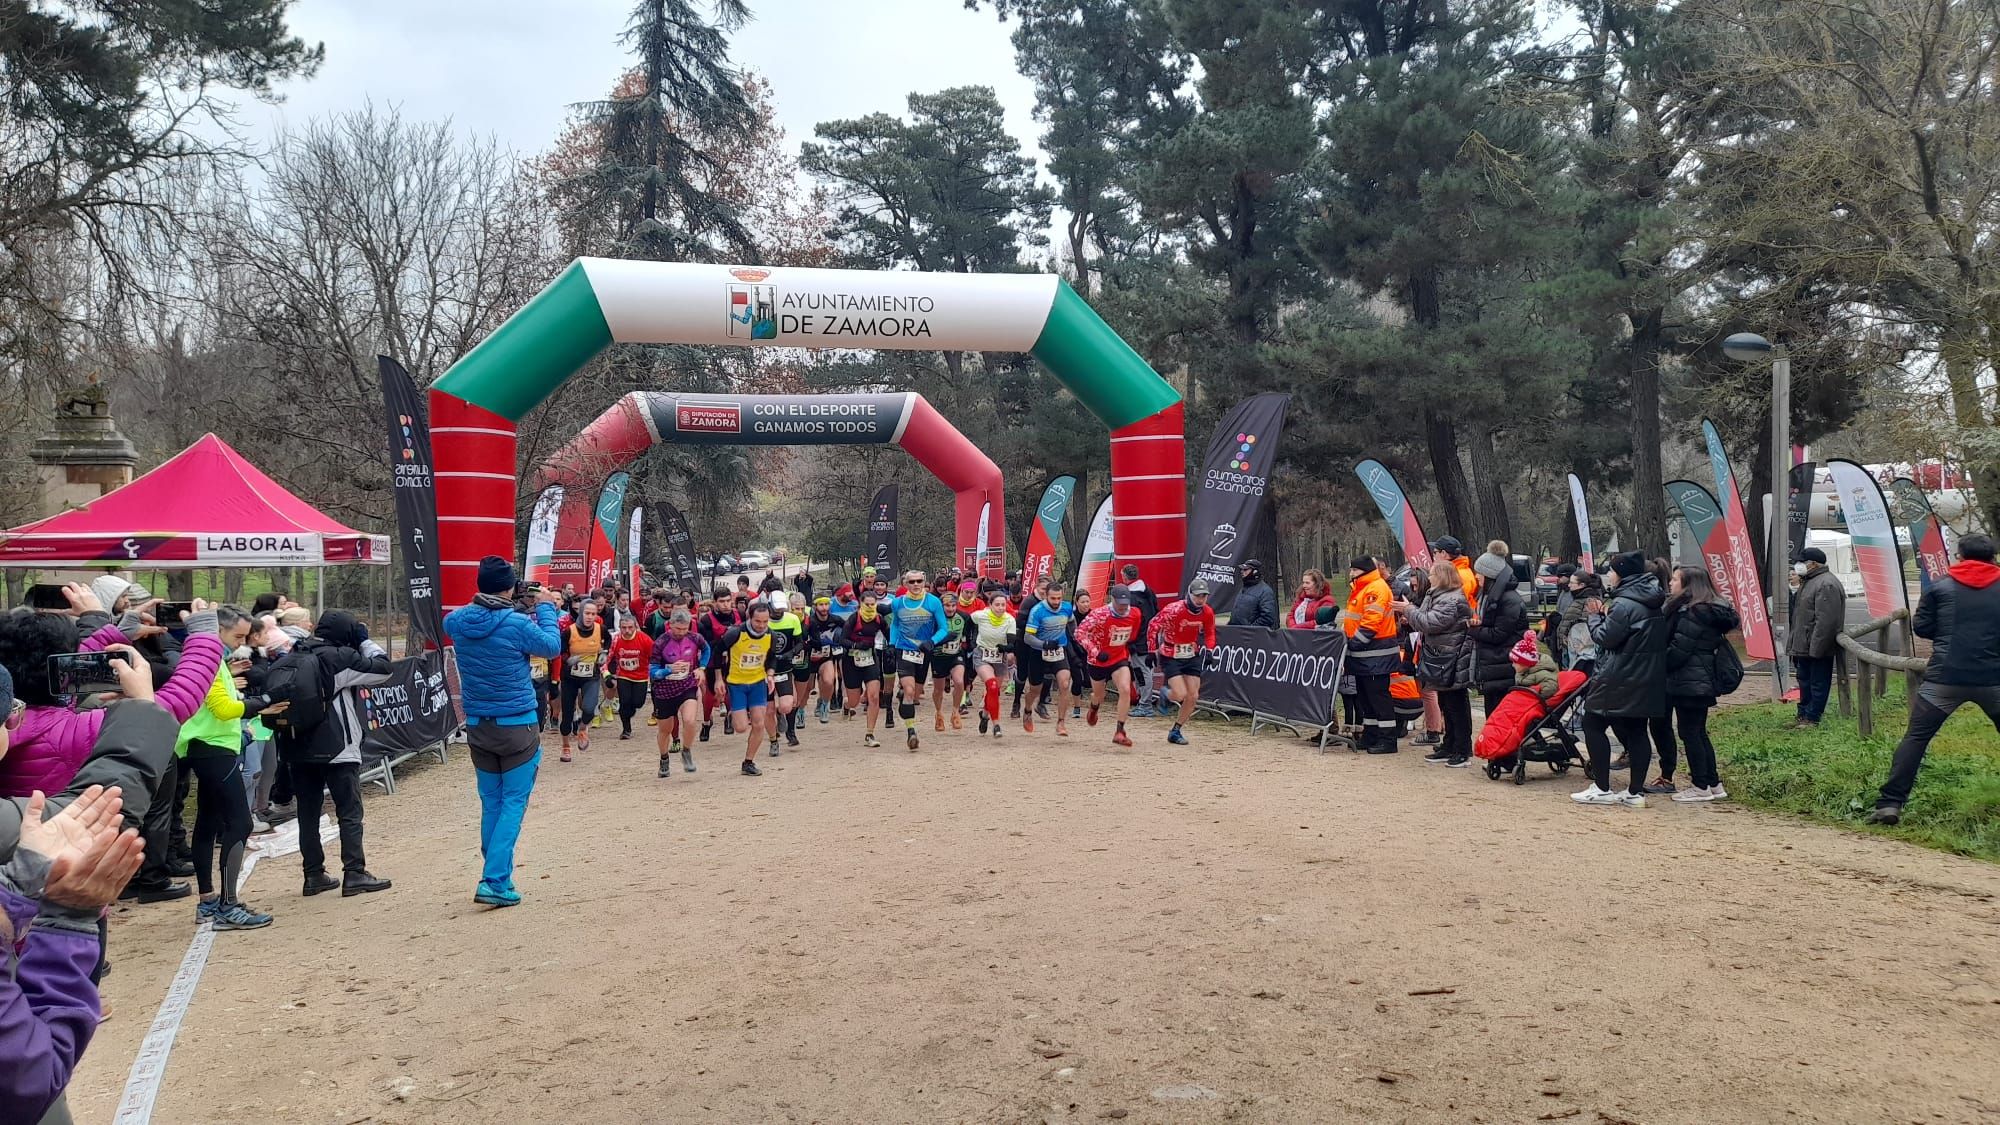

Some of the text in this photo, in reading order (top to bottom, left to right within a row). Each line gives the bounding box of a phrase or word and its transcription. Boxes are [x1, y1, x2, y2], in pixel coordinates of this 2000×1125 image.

[782, 293, 934, 313] AYUNTAMIENTO
[781, 315, 932, 337] DE ZAMORA
[753, 404, 877, 416] CON EL DEPORTE
[691, 417, 737, 427] ZAMORA
[754, 421, 877, 433] GANAMOS TODOS
[1216, 481, 1263, 496] zamora
[207, 537, 305, 551] LABORAL
[1195, 571, 1235, 585] ZAMORA
[1266, 651, 1335, 689] zamora
